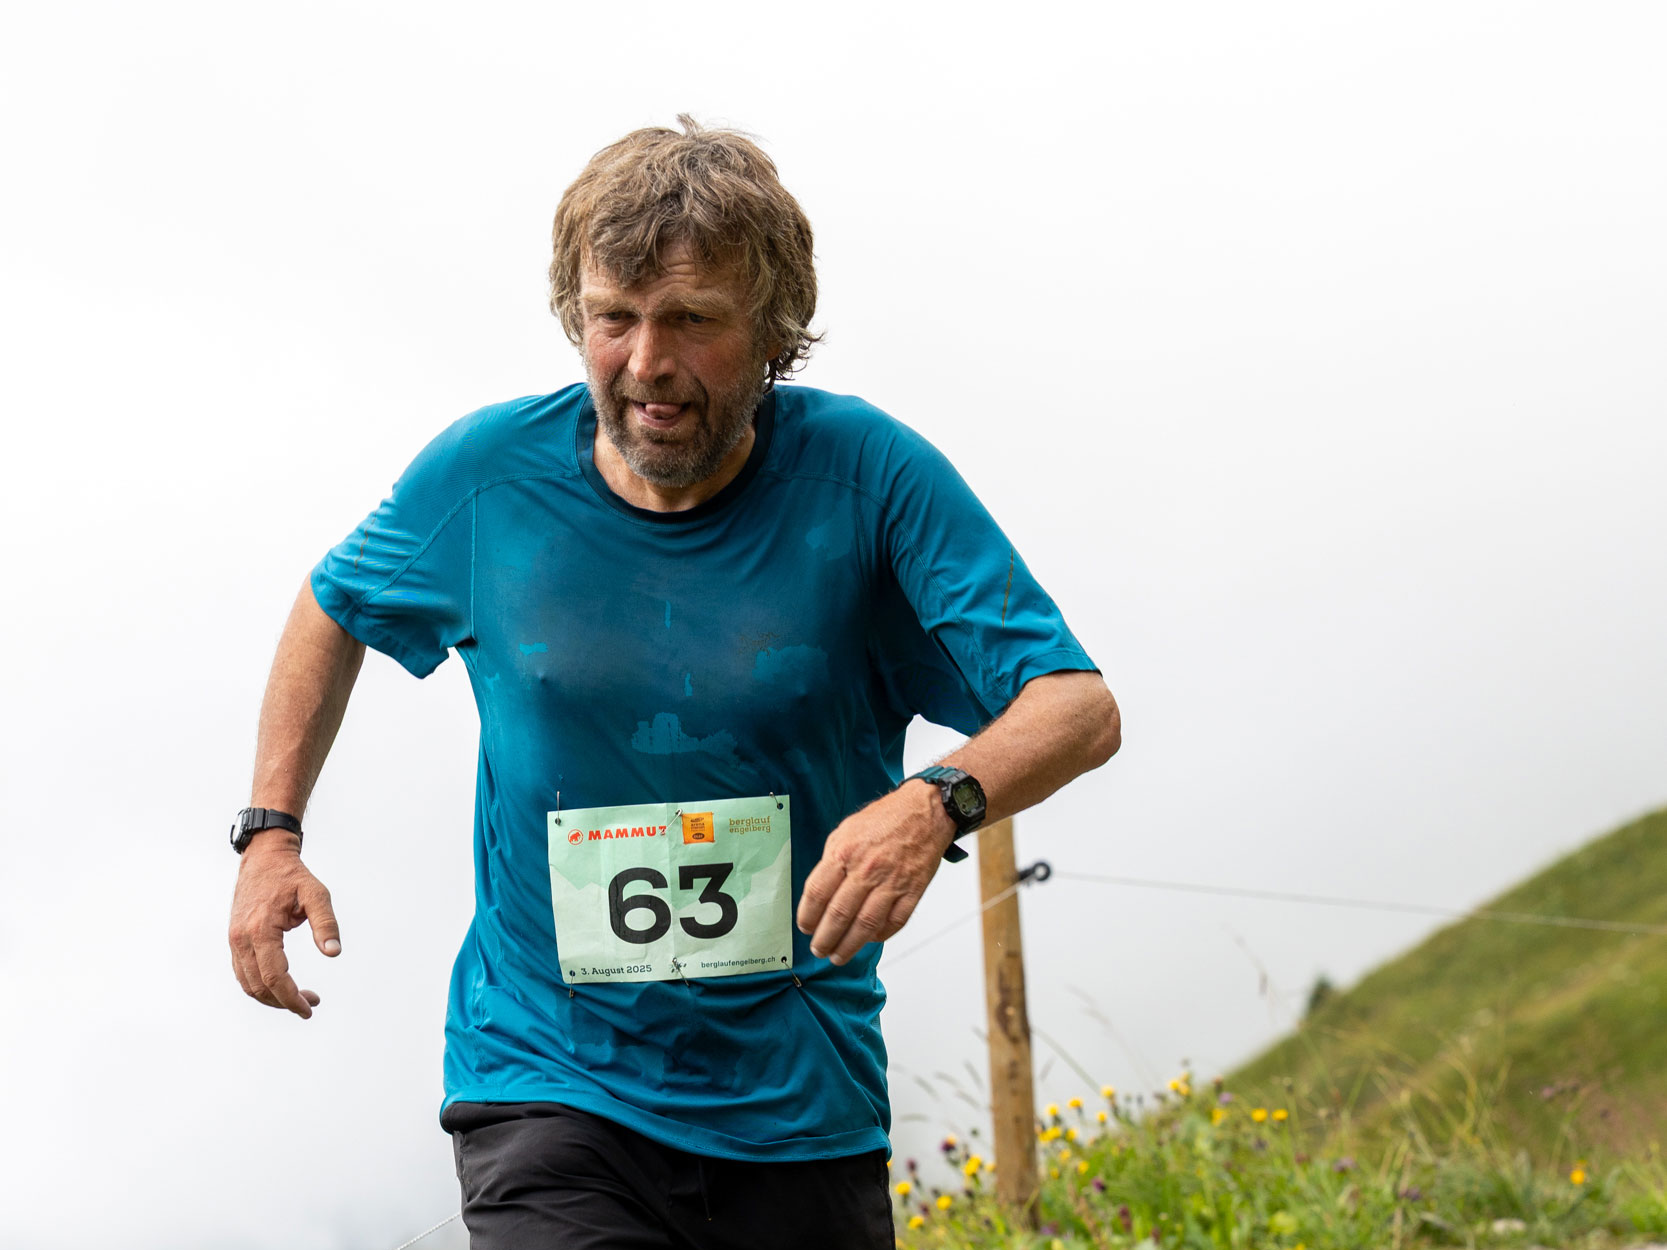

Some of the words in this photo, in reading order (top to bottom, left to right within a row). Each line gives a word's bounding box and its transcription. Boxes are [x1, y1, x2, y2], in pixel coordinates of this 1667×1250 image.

[729, 816, 770, 827] berglauf
[729, 825, 771, 835] engelberg
[608, 862, 738, 944] 63
[701, 956, 776, 969] berglaufengelberg.ch
[580, 967, 590, 976] 3.
[591, 965, 625, 976] August
[626, 964, 652, 974] 2025
